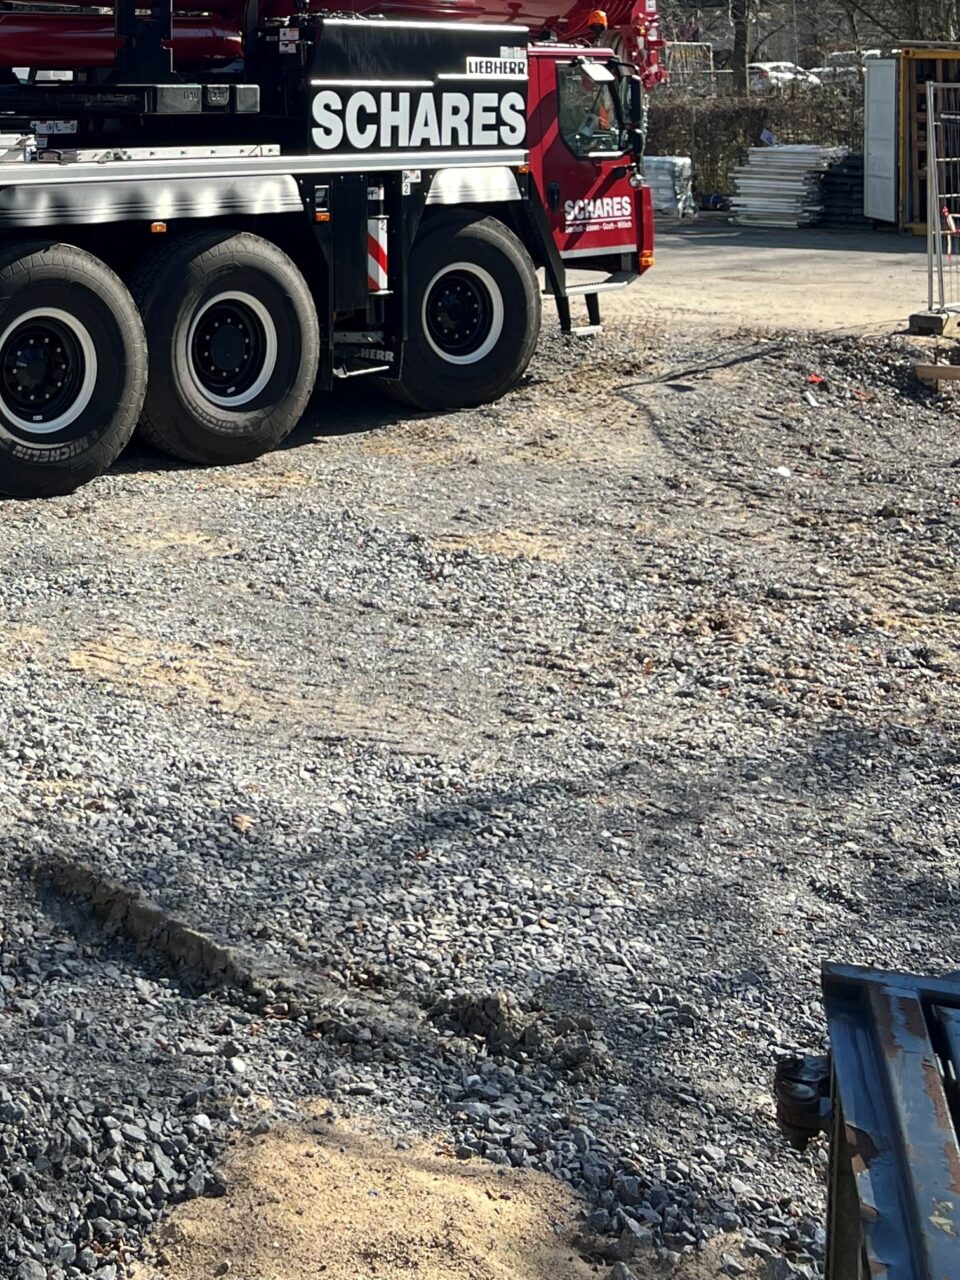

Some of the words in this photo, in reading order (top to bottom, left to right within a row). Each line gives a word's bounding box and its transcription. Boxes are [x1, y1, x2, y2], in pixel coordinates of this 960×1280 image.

[468, 60, 526, 75] LIEBHERR
[311, 89, 526, 150] SCHARES
[403, 183, 409, 194] 2
[565, 196, 632, 220] SCHARES
[380, 219, 386, 231] 2
[11, 435, 90, 463] MICHELIN
